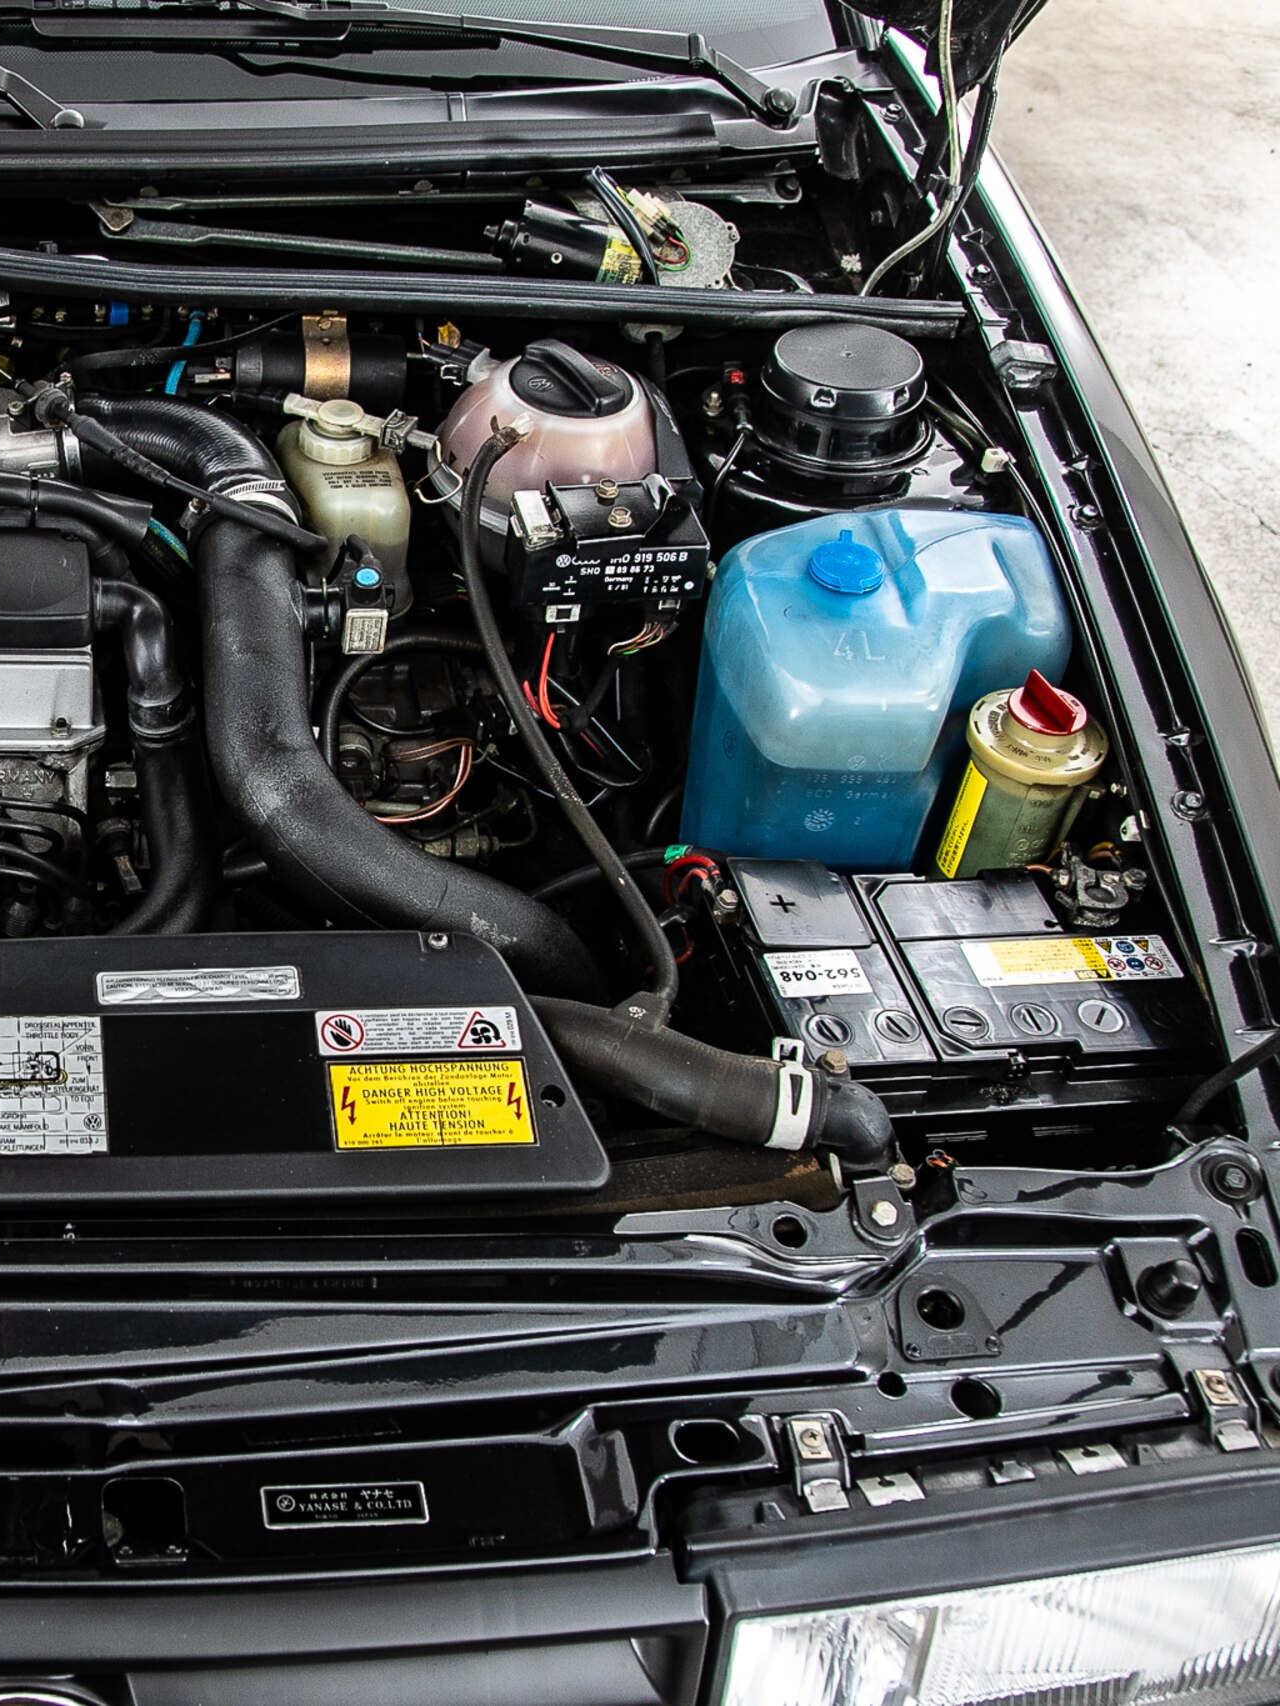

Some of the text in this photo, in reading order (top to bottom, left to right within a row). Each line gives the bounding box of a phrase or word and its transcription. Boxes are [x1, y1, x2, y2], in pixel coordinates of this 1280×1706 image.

[634, 553, 653, 563] 919
[780, 968, 862, 983] 562-048
[349, 1063, 509, 1075] ACHTUNG HOCHSPANNUNG
[440, 1073, 487, 1081] Zündanlage
[362, 1086, 503, 1099] DANGER HIGH VOLTAGE
[365, 1097, 392, 1105] Switch
[408, 1097, 436, 1105] engine
[467, 1095, 502, 1103] touching
[403, 1104, 436, 1112] ignition
[400, 1110, 471, 1121] ATTENTION!
[389, 1119, 486, 1131] HAUTE TENSION
[360, 1488, 395, 1500] ヤナセ
[298, 1501, 349, 1513] YANASE
[354, 1500, 363, 1511] &
